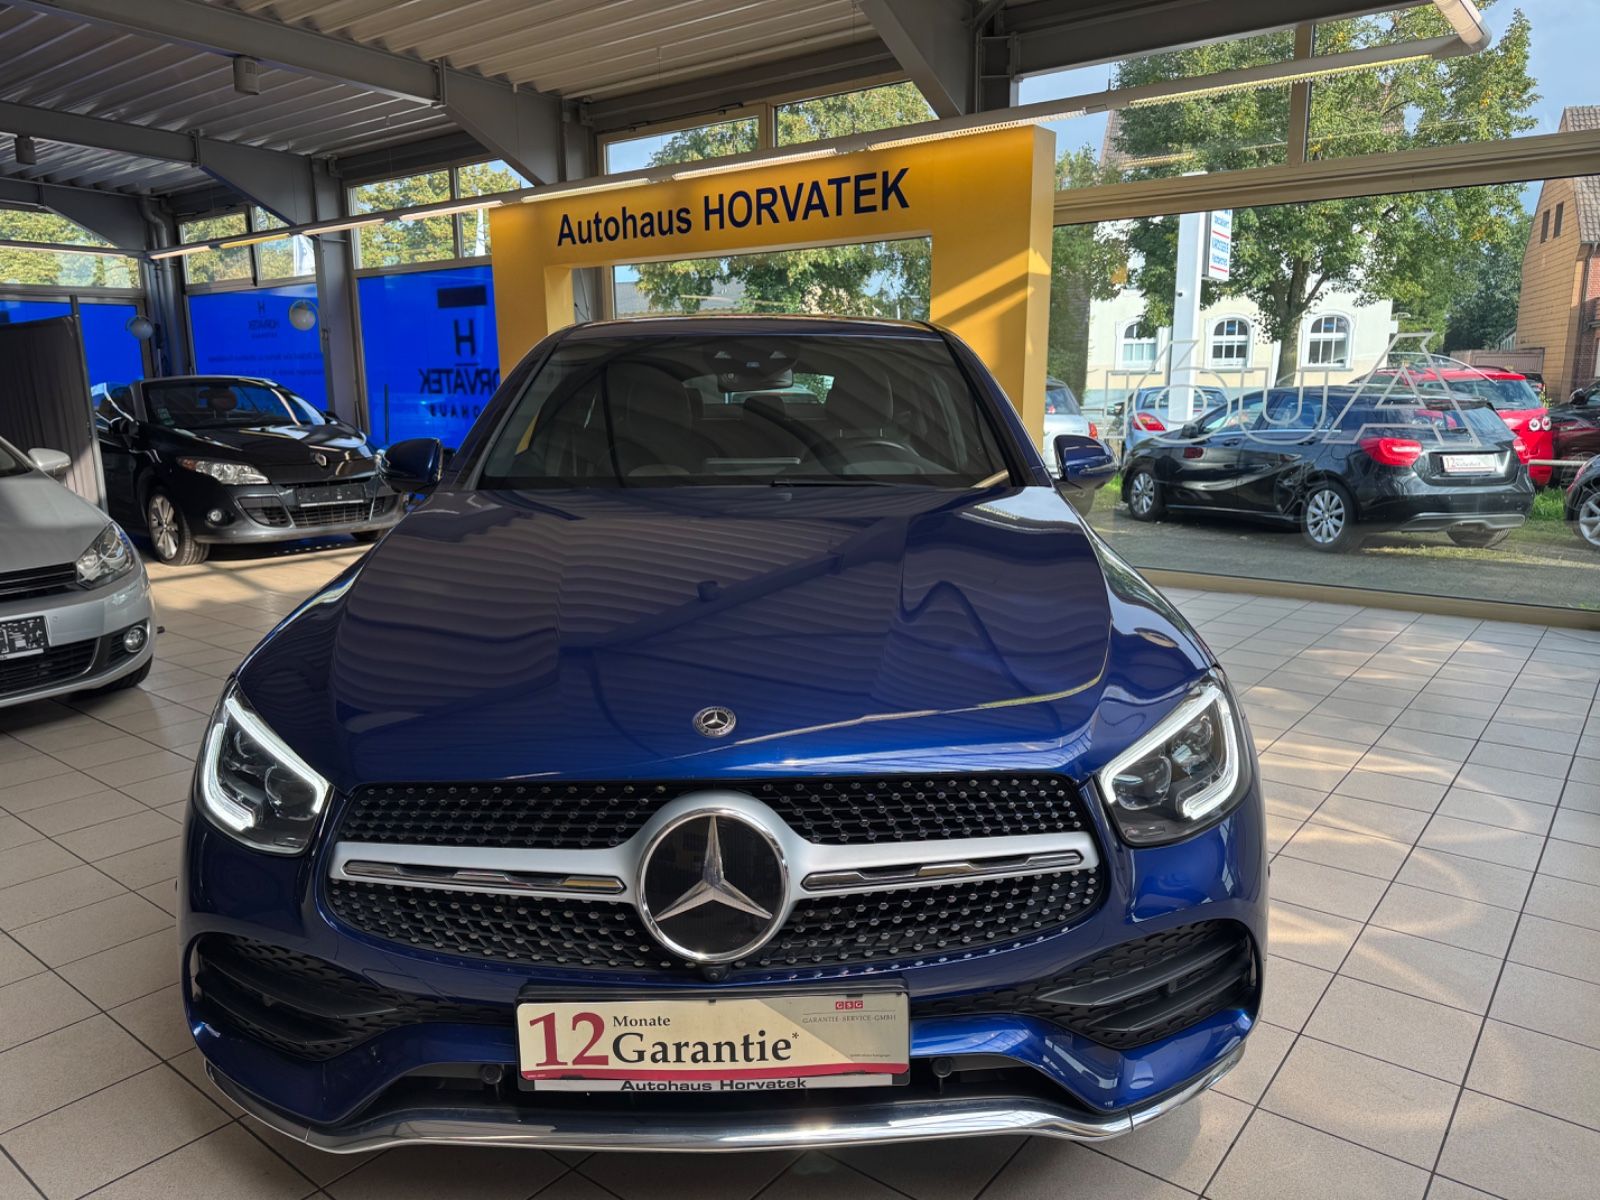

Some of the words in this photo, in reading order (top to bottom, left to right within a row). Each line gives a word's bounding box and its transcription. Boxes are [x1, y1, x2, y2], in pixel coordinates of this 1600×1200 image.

[556, 205, 692, 247] Autohaus
[703, 168, 910, 231] HORVATEK
[612, 1014, 671, 1028] Monate
[529, 1011, 610, 1068] 12
[620, 1079, 713, 1093] Autohaus
[720, 1078, 807, 1092] Horvatek
